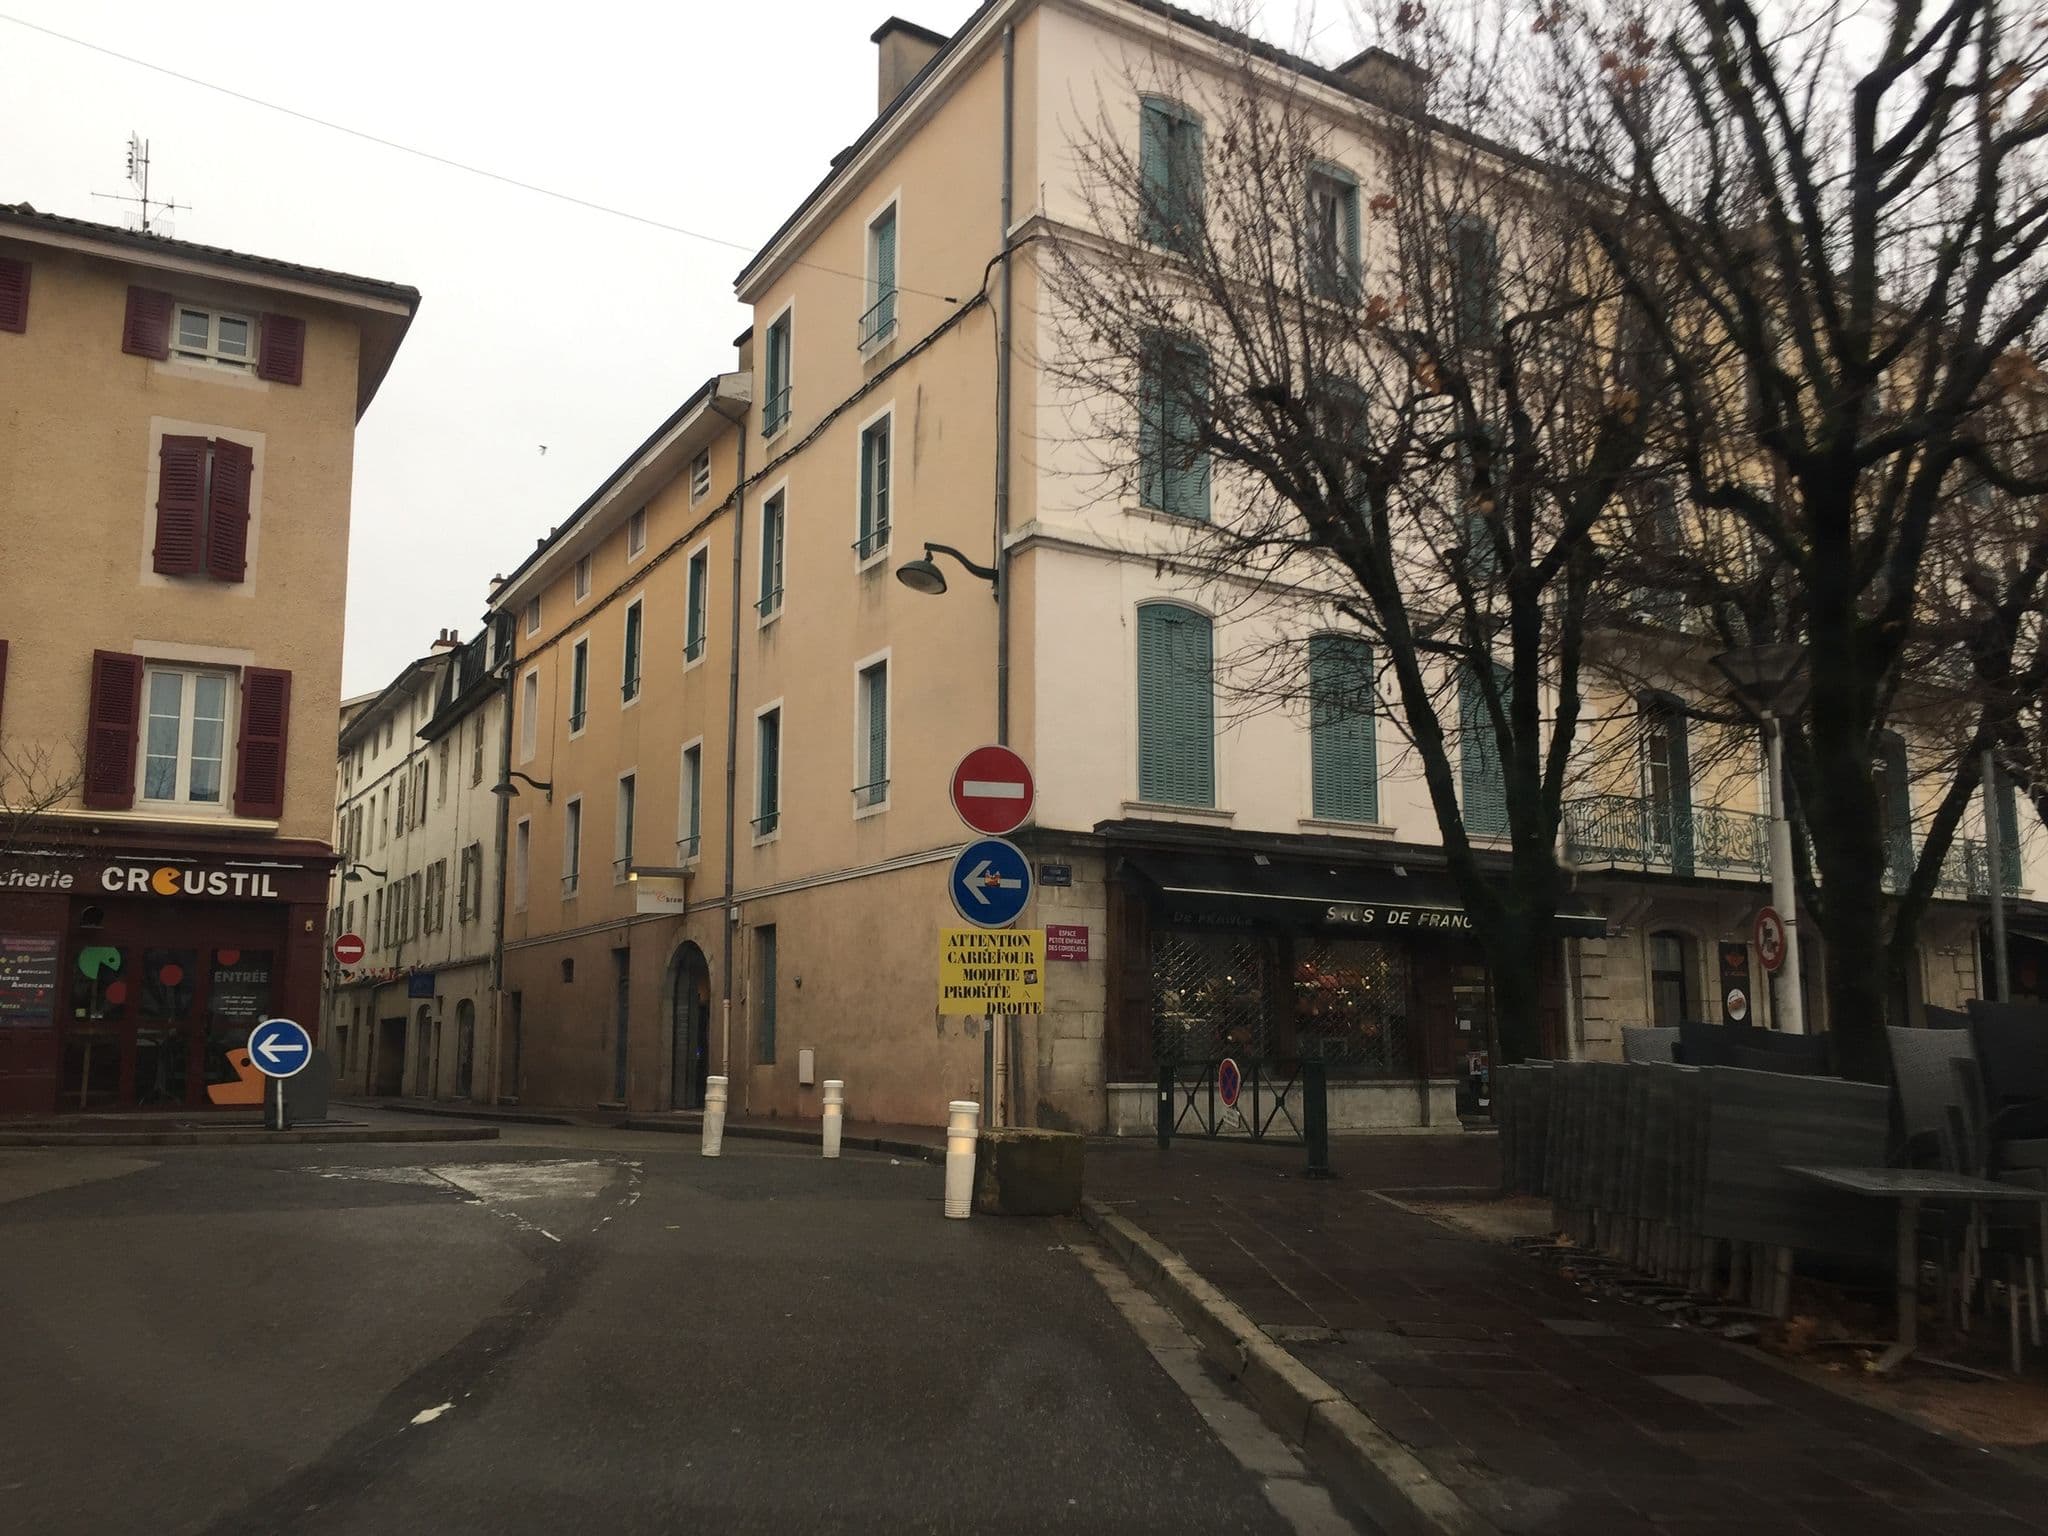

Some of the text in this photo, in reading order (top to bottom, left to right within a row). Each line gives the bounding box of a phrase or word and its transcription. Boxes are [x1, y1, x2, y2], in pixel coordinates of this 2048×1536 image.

[1387, 910, 1411, 925] DE
[948, 934, 1031, 947] ATTENTION
[947, 951, 1034, 964] CARREFOUR
[214, 969, 268, 983] ENTRÉE
[986, 1001, 1042, 1015] DROITE
